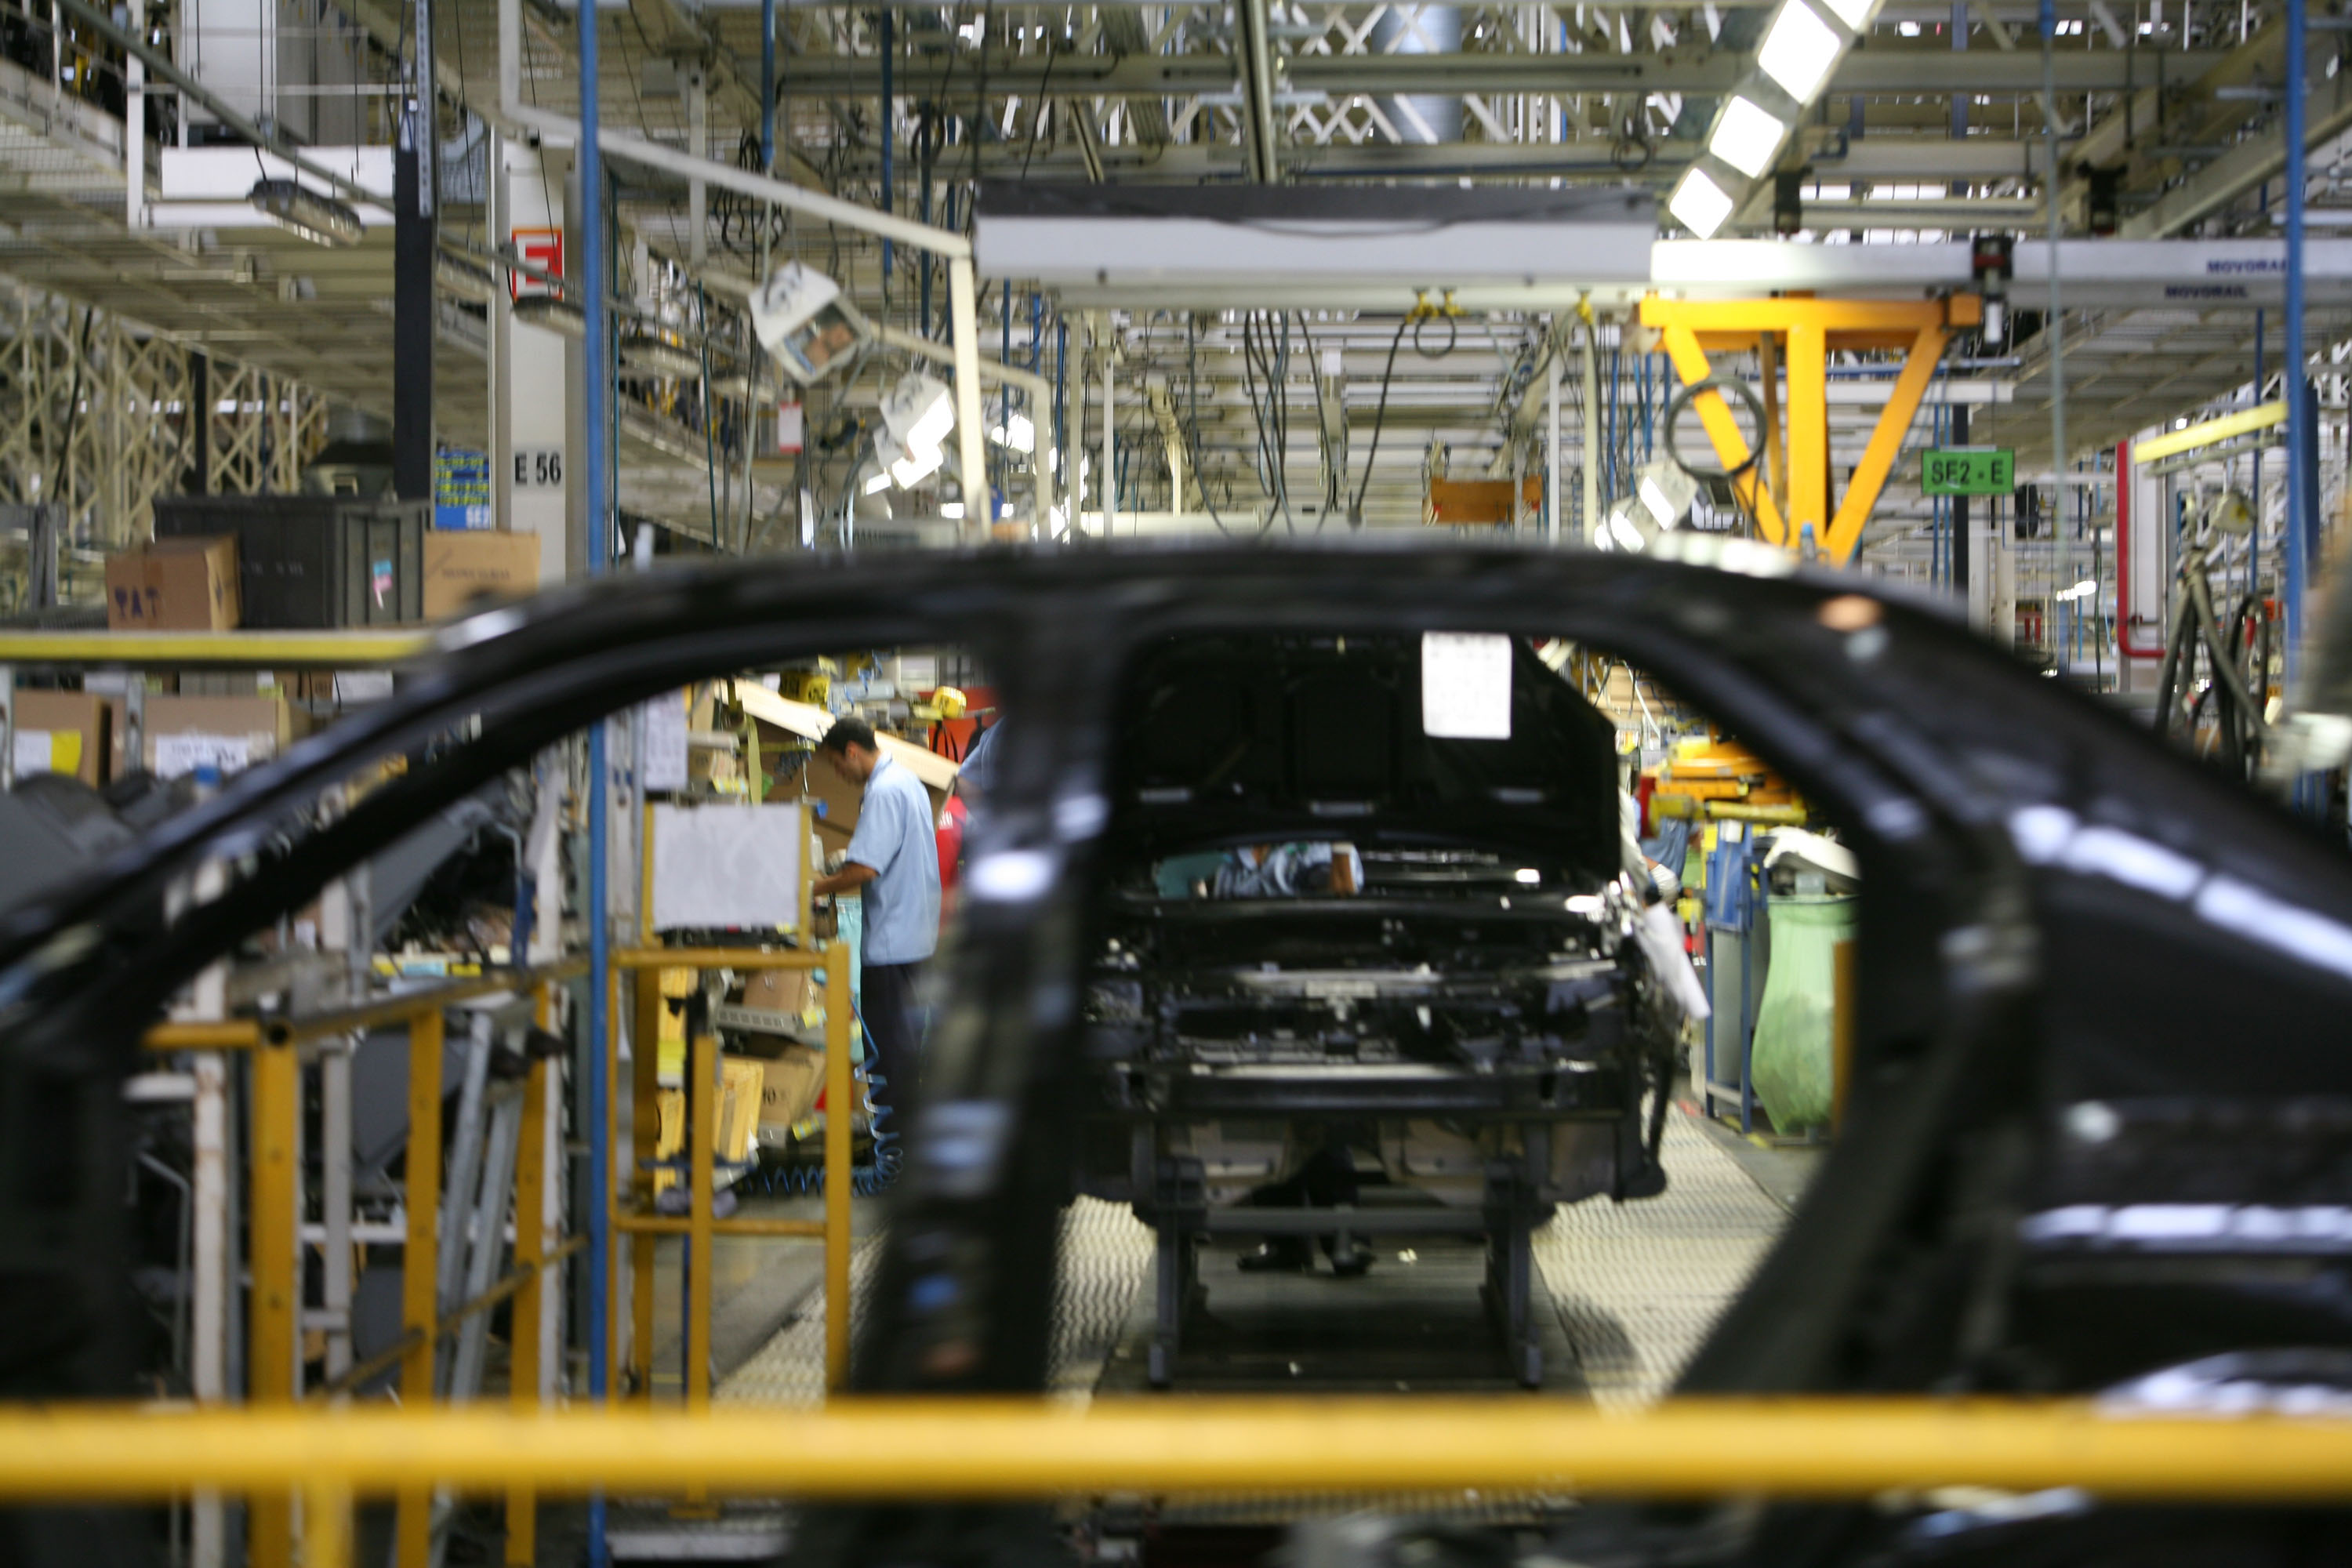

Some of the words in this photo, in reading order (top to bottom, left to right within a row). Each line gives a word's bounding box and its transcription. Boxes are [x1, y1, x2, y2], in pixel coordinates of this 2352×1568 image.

[2206, 260, 2288, 273] MOVORAI
[514, 452, 528, 485] E
[536, 452, 561, 485] 56
[1931, 459, 1970, 485] SE2
[1991, 459, 2003, 485] E
